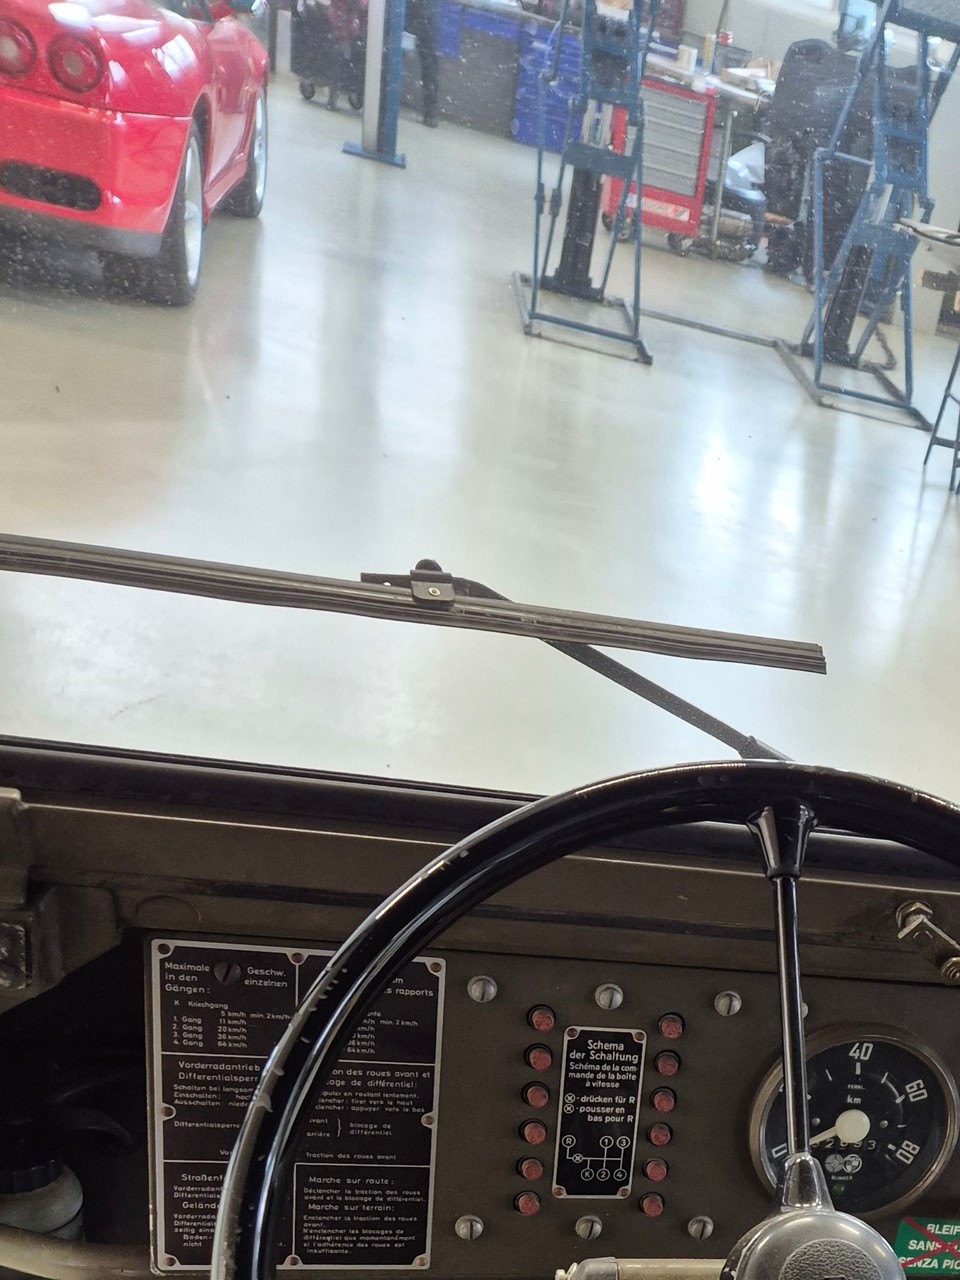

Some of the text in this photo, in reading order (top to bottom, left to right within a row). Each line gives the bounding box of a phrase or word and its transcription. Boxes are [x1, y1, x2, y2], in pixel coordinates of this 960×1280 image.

[164, 962, 286, 977] Maximale Geschw.
[178, 973, 198, 981] den
[244, 978, 288, 988] einzelnen
[395, 988, 434, 997] rapports
[188, 1001, 229, 1010] Kriechgang
[182, 1016, 202, 1024] Gang
[182, 1024, 203, 1032] Gang
[182, 1032, 203, 1040] Gang
[182, 1039, 203, 1048] Gang
[587, 1039, 624, 1051] Schema
[849, 1043, 873, 1061] 40
[569, 1050, 639, 1064] der Schaltung
[178, 1061, 260, 1071] Vorderradantrieb
[569, 1062, 600, 1071] Schéma
[601, 1063, 611, 1071] de
[612, 1063, 620, 1072] la
[178, 1072, 259, 1082] Differentialsperr
[569, 1071, 615, 1080] mande de la
[592, 1080, 620, 1088] vitesse
[905, 1079, 928, 1102] 60
[615, 1095, 636, 1104] für R
[847, 1095, 862, 1104] km
[588, 1114, 634, 1123] bas pour R
[895, 1140, 921, 1165] 80
[309, 1176, 341, 1184] Marche
